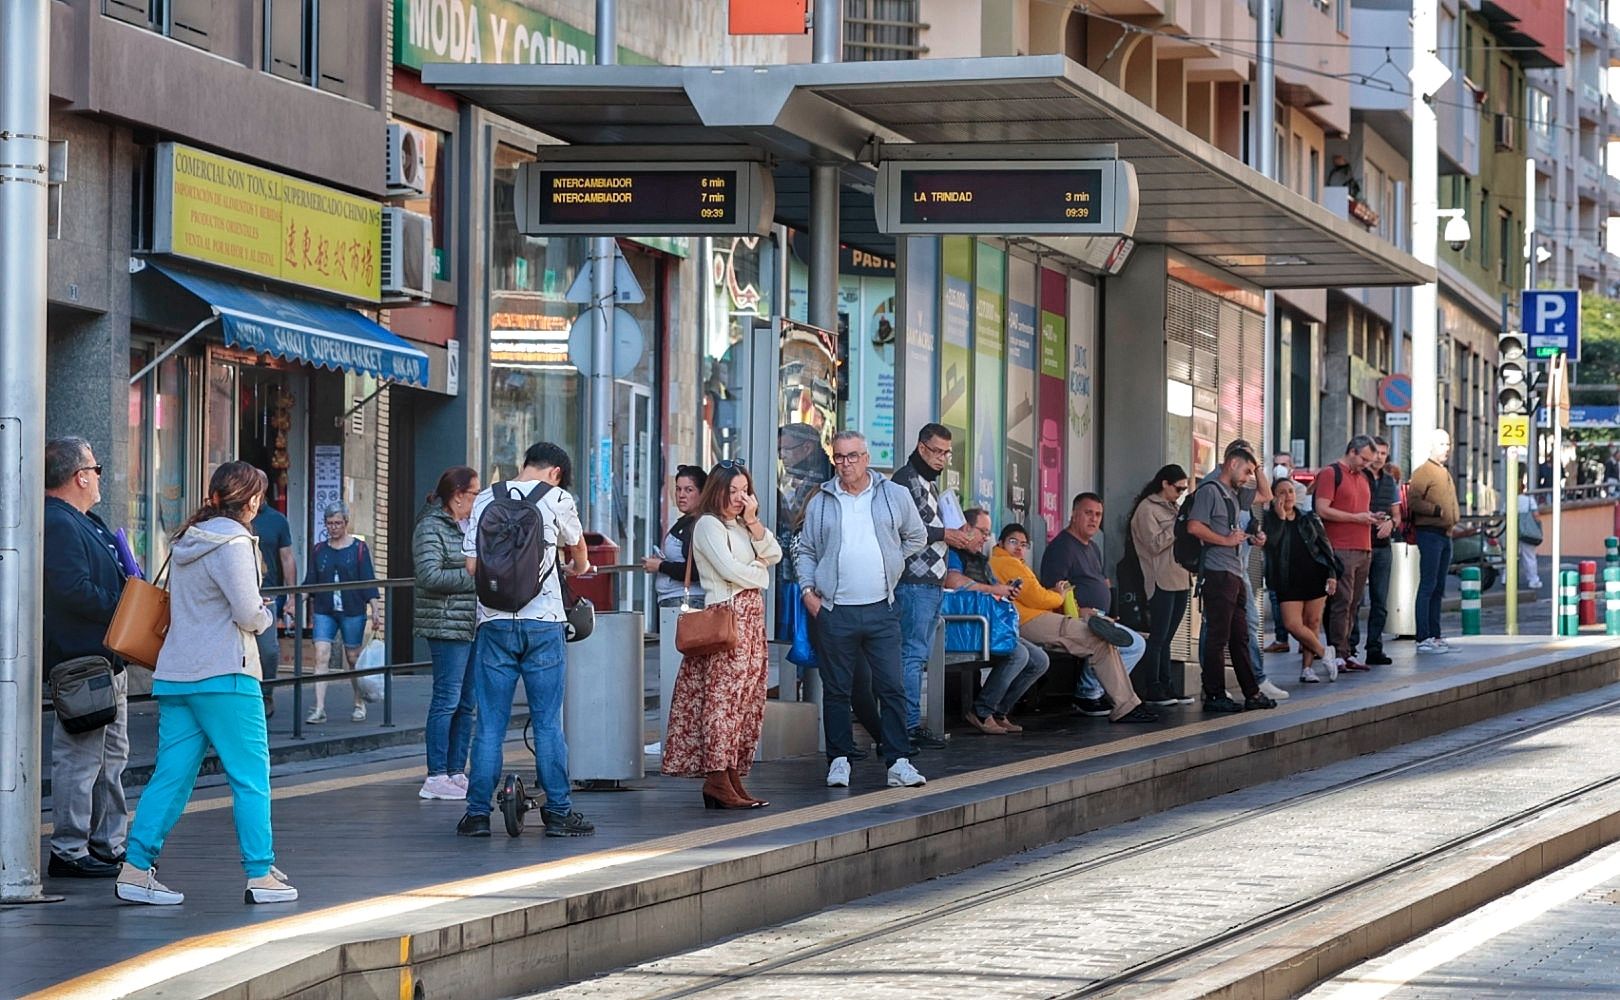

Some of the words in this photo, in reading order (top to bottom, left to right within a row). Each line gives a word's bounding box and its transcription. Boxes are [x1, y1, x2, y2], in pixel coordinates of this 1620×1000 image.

[409, 0, 482, 64] MODA
[490, 13, 508, 64] Y
[175, 152, 226, 186] COMERCIAL
[228, 168, 246, 190] SON
[553, 178, 632, 188] INTERCAMBIADOR
[701, 178, 707, 188] 6
[709, 178, 725, 188] min
[284, 185, 343, 217] SUPERMERCADO
[344, 201, 368, 223] CHINO
[553, 193, 632, 203] INTERCAMBIADOR
[701, 193, 707, 203] 7
[709, 193, 725, 203] min
[914, 192, 927, 202] LA
[931, 192, 973, 202] TRINIDAD
[1065, 192, 1072, 202] 3
[1074, 192, 1090, 202] min
[701, 209, 724, 218] 09:39
[1065, 208, 1089, 218] 09:39
[190, 209, 225, 232] PRODUCTOS
[225, 218, 259, 240] ORIENTALES
[1536, 294, 1566, 333] P
[274, 327, 308, 358] SAROJ
[310, 336, 383, 371] SUPERMARKET
[1502, 424, 1525, 438] 25
